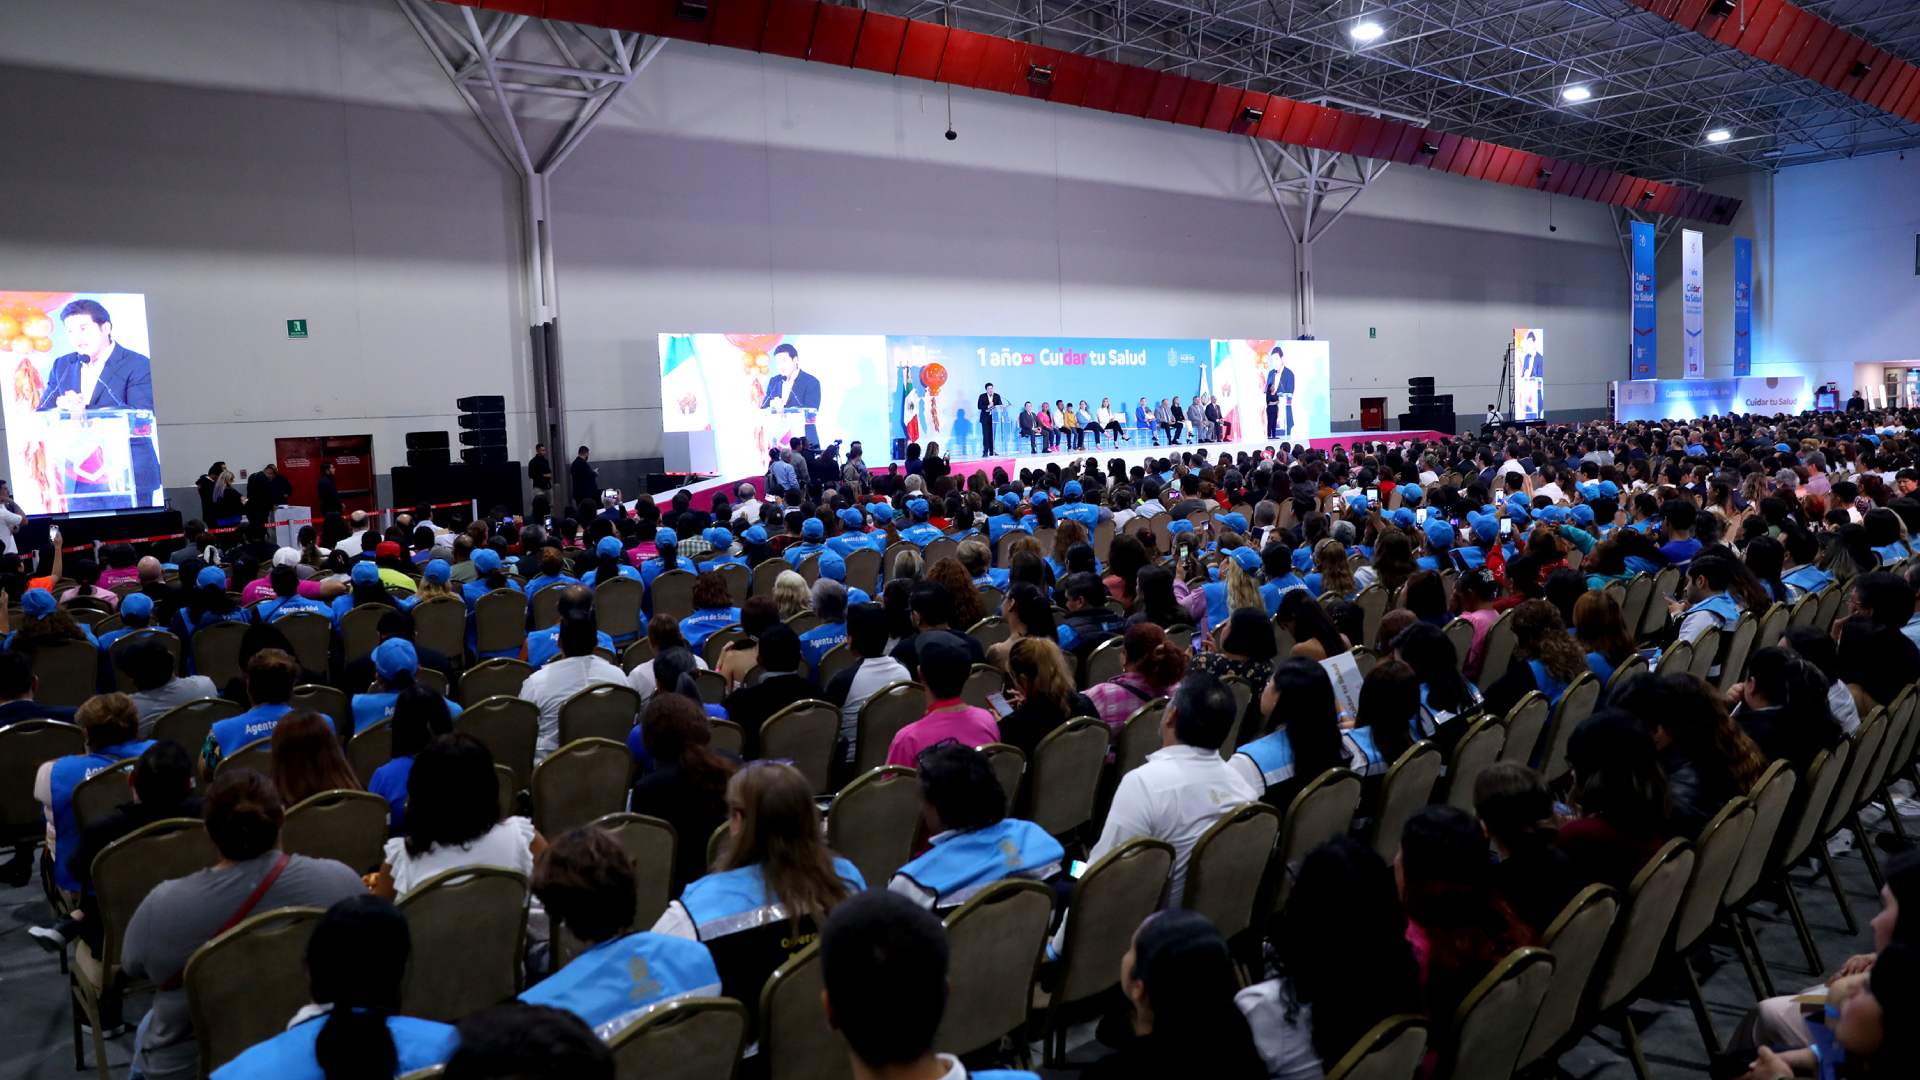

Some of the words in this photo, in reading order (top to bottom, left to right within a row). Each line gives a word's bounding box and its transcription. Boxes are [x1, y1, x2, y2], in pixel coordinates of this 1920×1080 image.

[977, 348, 986, 366] 1
[989, 347, 1022, 367] año
[1039, 347, 1087, 367] Cuidar
[1089, 350, 1106, 366] tu
[1108, 349, 1147, 366] Salud
[1745, 397, 1767, 407] Cuidar
[1768, 398, 1778, 406] tu
[1779, 397, 1798, 406] Salud
[687, 615, 709, 625] Agente
[709, 613, 717, 621] de
[717, 613, 732, 621] Salud
[810, 636, 834, 649] Agente
[244, 720, 279, 736] Agente
